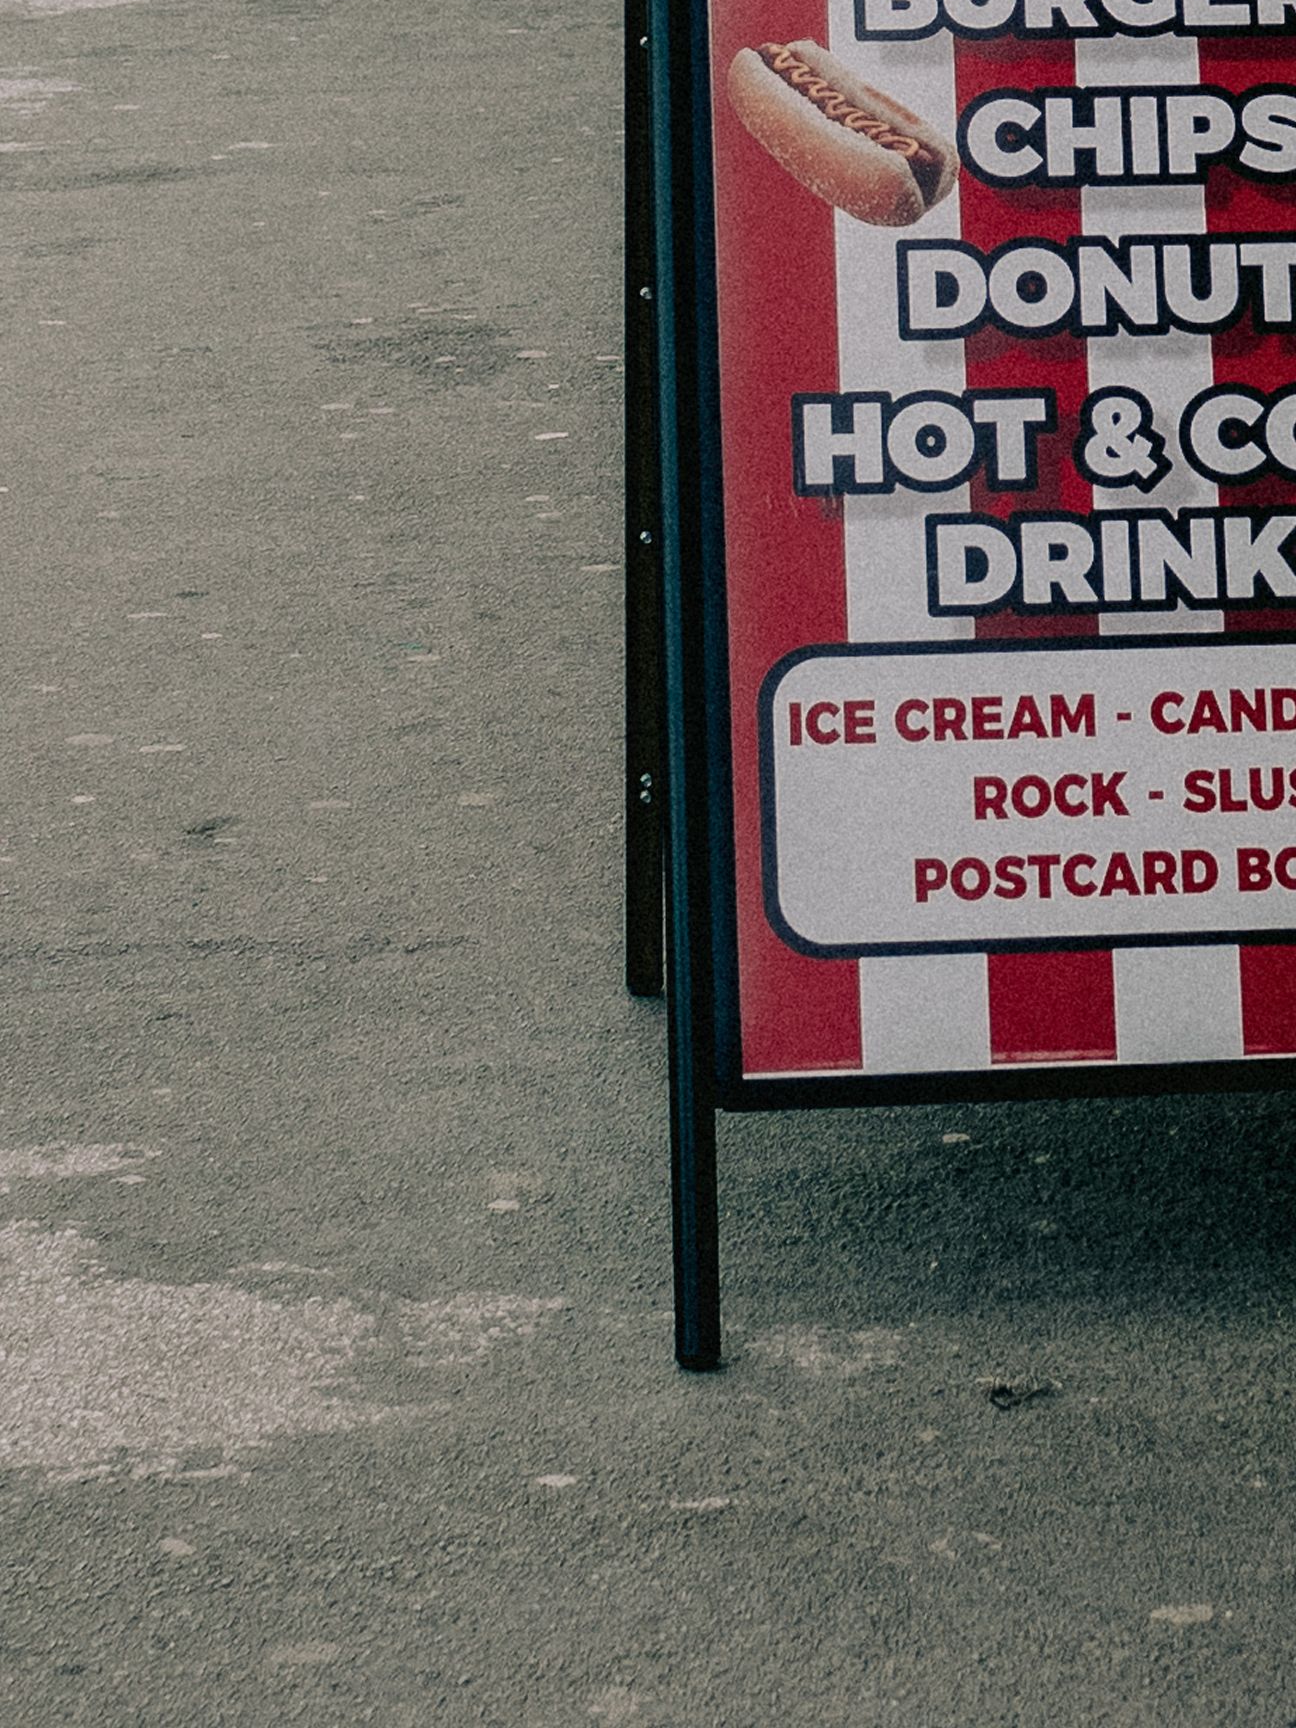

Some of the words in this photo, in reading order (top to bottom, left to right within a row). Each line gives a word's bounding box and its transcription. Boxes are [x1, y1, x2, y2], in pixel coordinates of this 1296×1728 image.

[795, 391, 1053, 492] HOT
[1077, 386, 1169, 490] &
[788, 700, 877, 746] ICE
[893, 692, 1098, 743] CREAM
[972, 770, 1130, 822] ROCK
[914, 849, 1219, 904] POSTCARD
